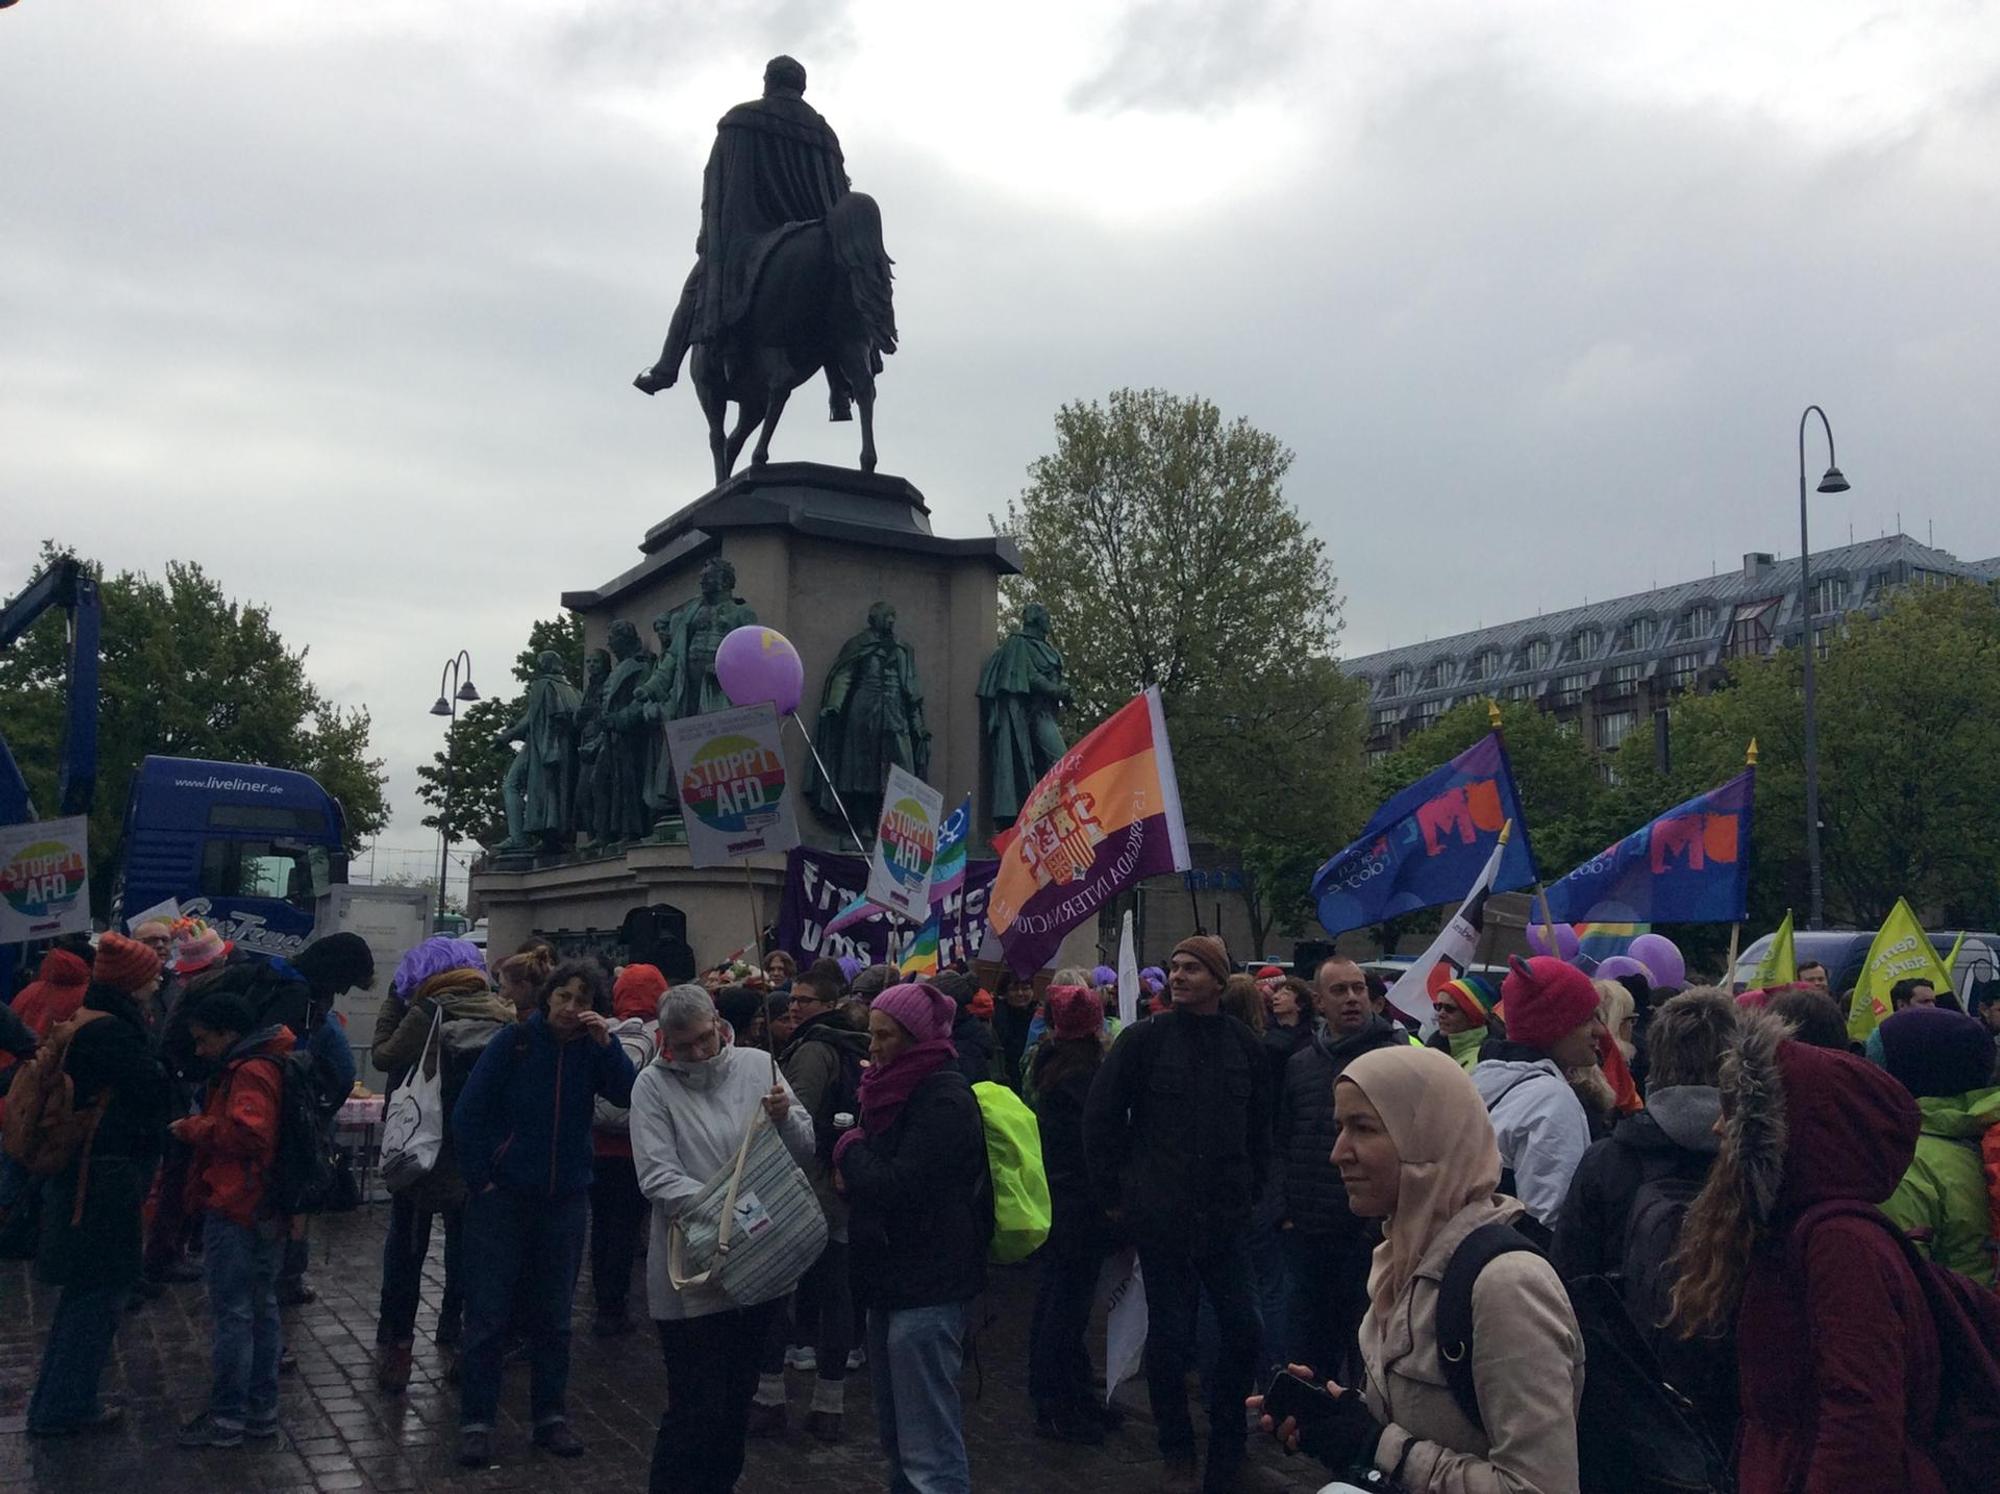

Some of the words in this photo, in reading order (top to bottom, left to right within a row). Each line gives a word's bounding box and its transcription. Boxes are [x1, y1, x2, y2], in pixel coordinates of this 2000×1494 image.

[175, 776, 284, 794] www.liveliner.de
[689, 748, 771, 791] STOPPT
[716, 775, 766, 819] AFD
[886, 810, 934, 850] STOPPT
[894, 835, 922, 874] AFD
[26, 873, 67, 905] AFD
